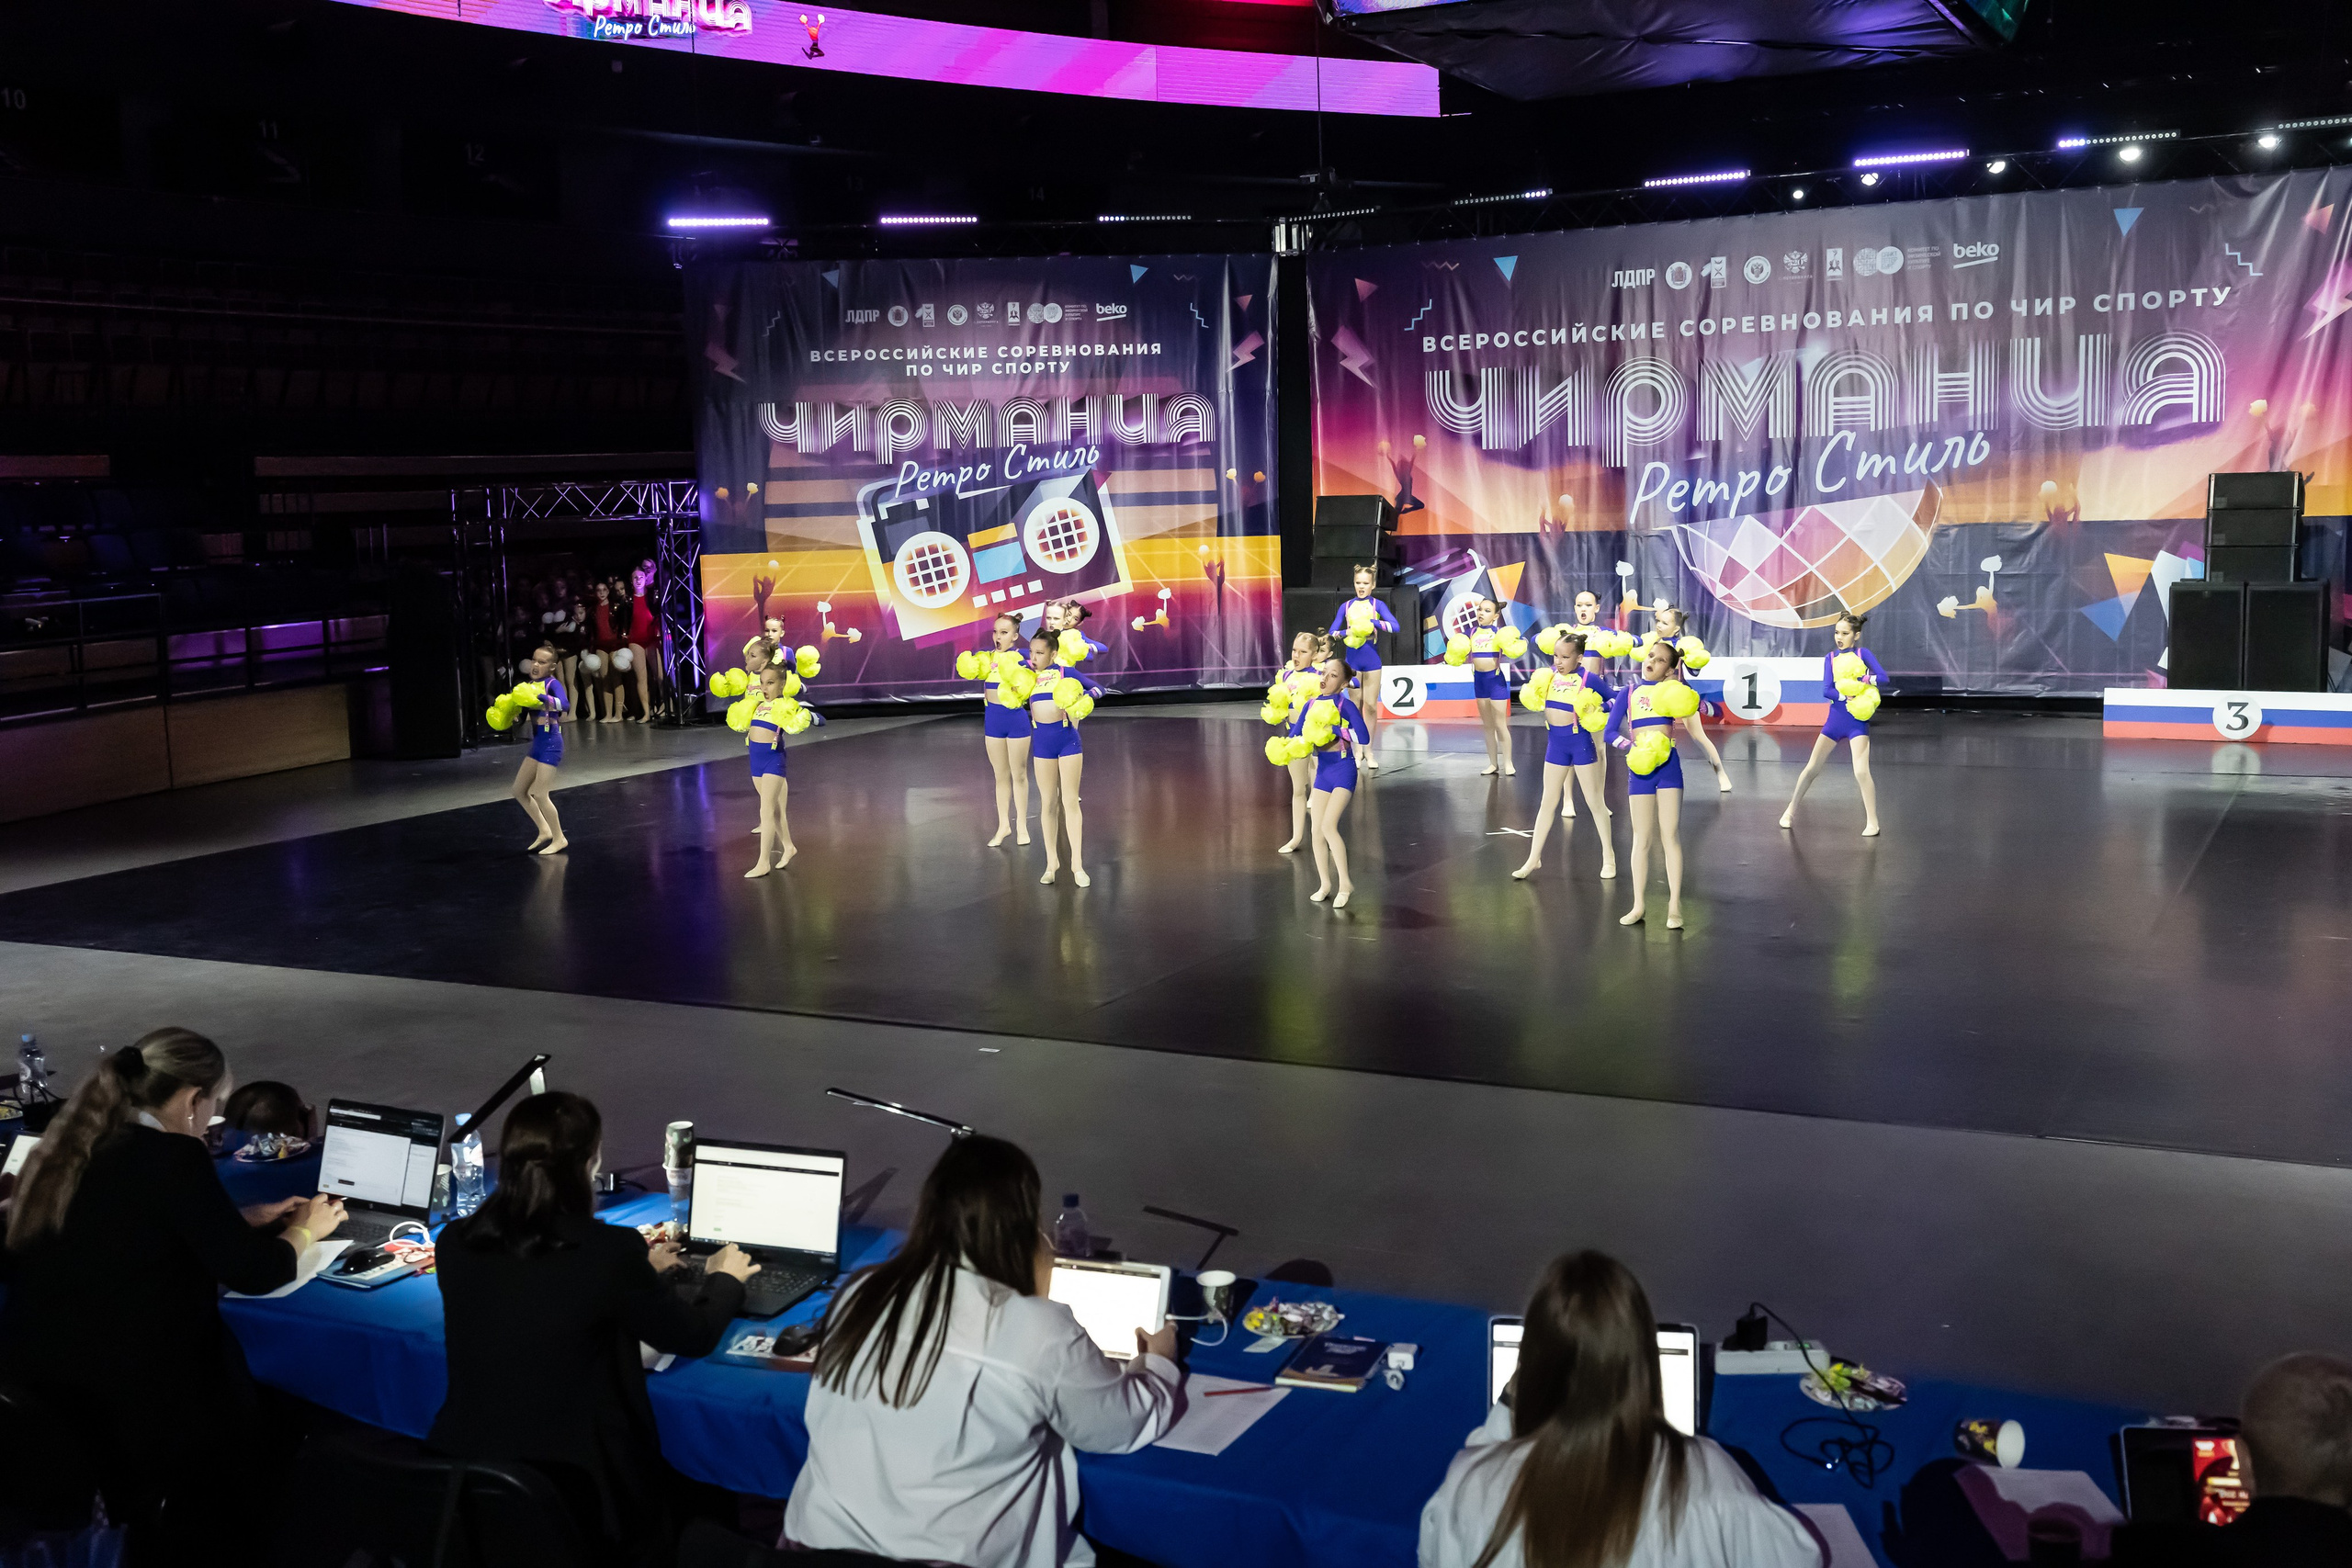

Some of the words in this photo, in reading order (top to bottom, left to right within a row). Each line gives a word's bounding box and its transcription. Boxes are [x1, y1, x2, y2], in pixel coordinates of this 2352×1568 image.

[594, 15, 643, 40] Ретро
[649, 15, 696, 36] Стиль
[2, 87, 27, 110] 10
[258, 118, 278, 140] 11
[465, 142, 484, 162] 12
[1028, 186, 1046, 201] 14
[1952, 241, 2000, 259] beko
[1611, 268, 1655, 289] ЛДПР
[845, 309, 880, 324] ЛДПР
[1096, 302, 1127, 315] beko
[1422, 321, 1666, 353] ВСЕРОССИЙСКИЕ
[1679, 304, 1934, 337] СОРЕВНОВАНИЯ
[1951, 300, 1994, 321] ПО
[2010, 297, 2076, 317] ЧИР
[2093, 287, 2232, 312] СПОРТУ
[810, 344, 988, 362] ВСЕРОССИЙСКИЕ
[997, 343, 1162, 359] СОРЕВНОВАНИЯ
[906, 364, 933, 377] ПО
[943, 363, 982, 376] ЧИР
[992, 361, 1071, 375] СПОРТУ
[895, 460, 991, 499] Ретро
[1004, 444, 1101, 479] Стиль
[1629, 462, 1793, 525] Ретро
[1815, 430, 1991, 493] Стиль
[1392, 676, 1415, 708] 2
[1741, 671, 1763, 710] 1
[2225, 701, 2249, 731] 3
